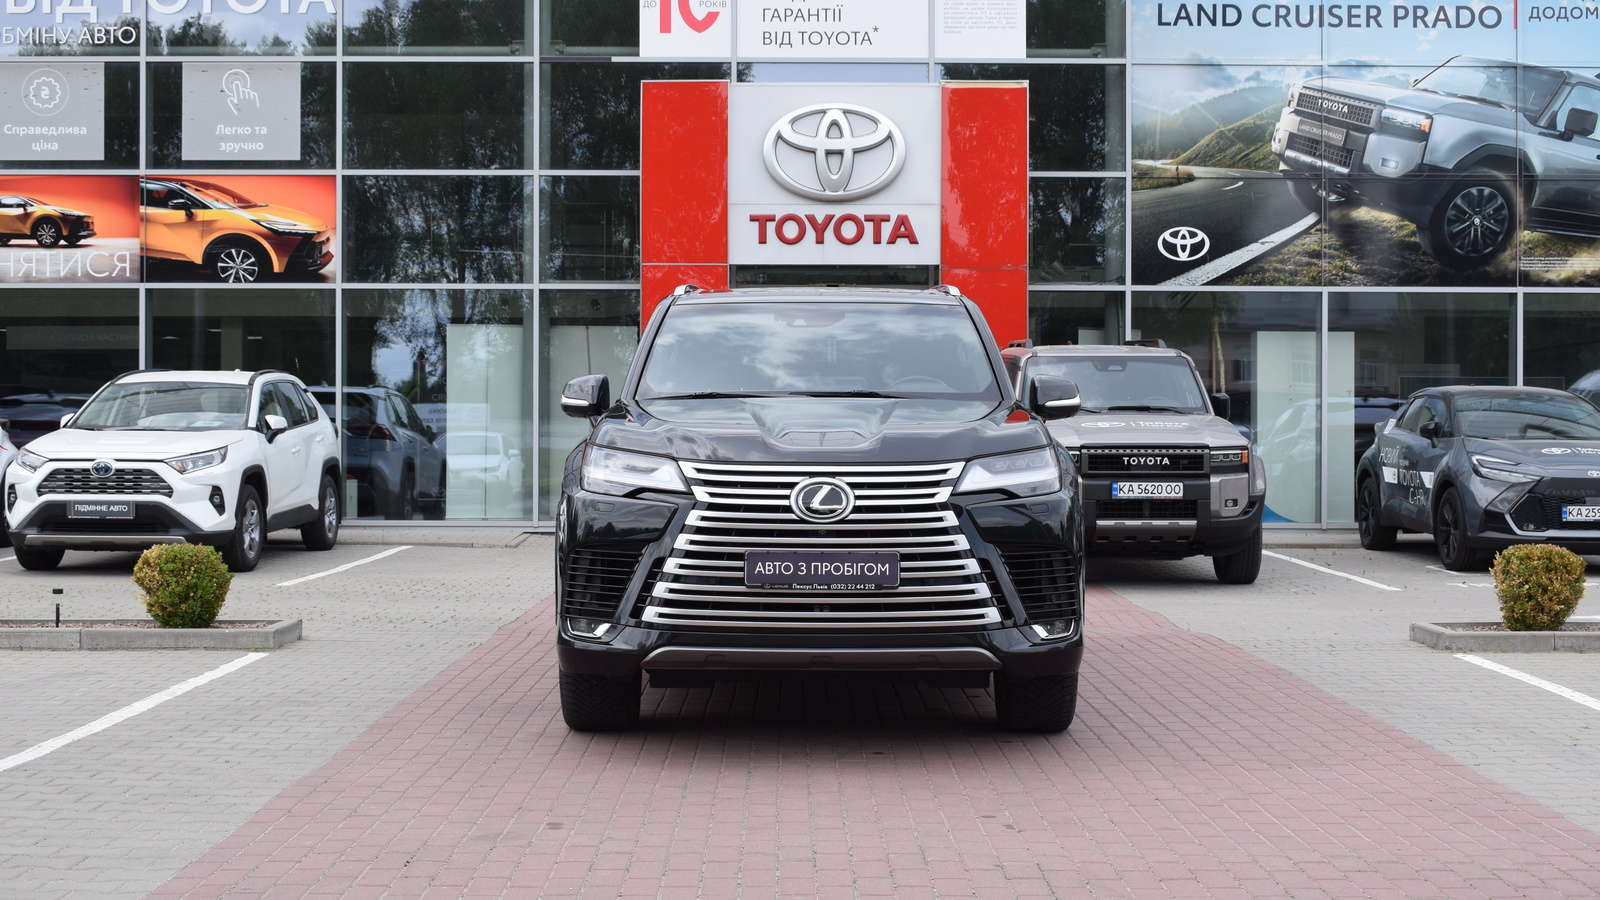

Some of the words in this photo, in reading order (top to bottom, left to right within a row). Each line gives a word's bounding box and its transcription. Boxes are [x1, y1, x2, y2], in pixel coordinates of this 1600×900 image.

[643, 0, 657, 9] ДО
[699, 0, 727, 8] РОКІВ
[762, 4, 843, 22] ГАРАНТІЇ
[1157, 3, 1242, 27] LAND
[1251, 4, 1382, 28] CRUISER
[1393, 4, 1502, 29] PRADO
[78, 26, 136, 44] АВТО
[762, 31, 793, 48] ВІД
[1317, 99, 1348, 113] TOYOTA
[4, 124, 87, 137] Справедлива
[216, 124, 251, 135] Легко
[252, 127, 267, 135] та
[32, 140, 59, 151] ціна
[219, 141, 264, 153] зручно
[749, 213, 919, 245] TOYOTA
[1122, 457, 1170, 465] TOYOTA
[1399, 469, 1421, 487] TOYOTA
[1118, 484, 1135, 495] KA
[1137, 484, 1163, 495] 5620
[1409, 488, 1426, 506] C-HR
[74, 504, 108, 512] ПІДМІННЕ
[109, 504, 128, 512] АВТО
[1568, 507, 1583, 518] KA
[754, 561, 794, 576] АВТО
[797, 561, 807, 576] З
[811, 561, 890, 576] ПРОБІГОМ
